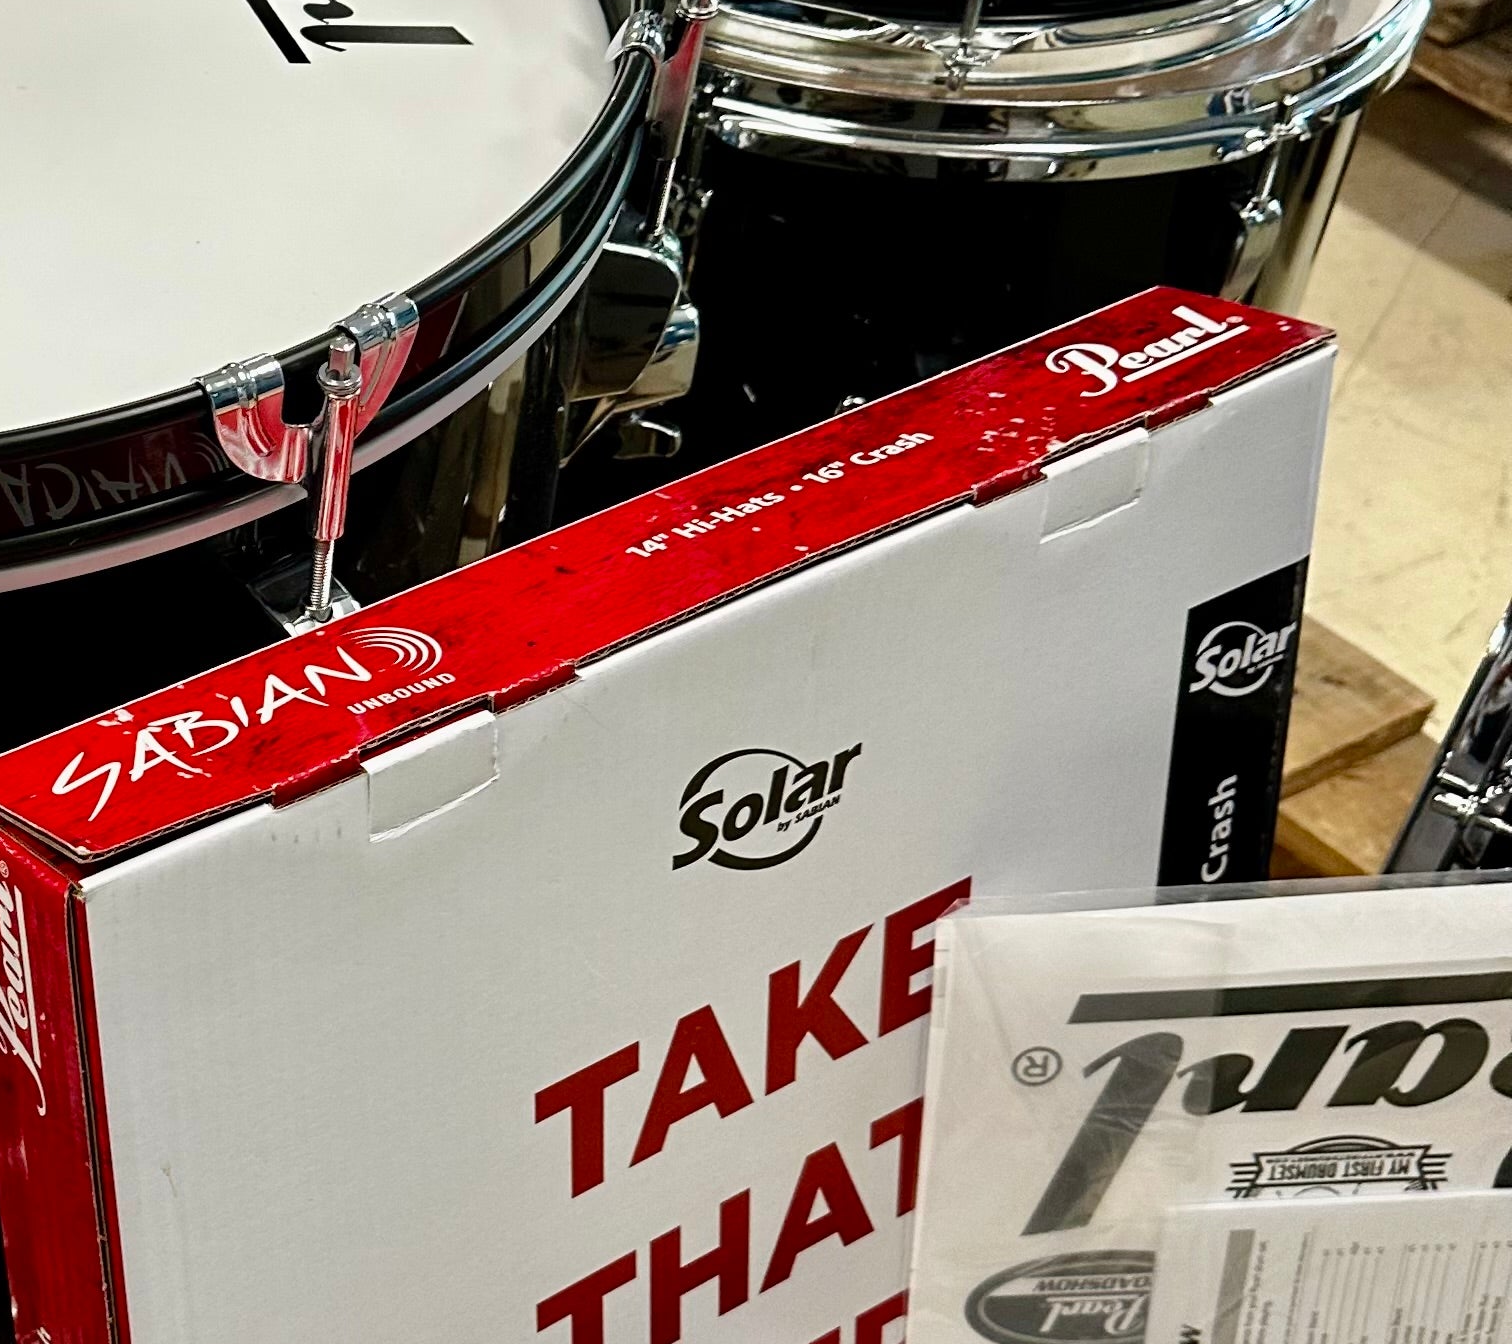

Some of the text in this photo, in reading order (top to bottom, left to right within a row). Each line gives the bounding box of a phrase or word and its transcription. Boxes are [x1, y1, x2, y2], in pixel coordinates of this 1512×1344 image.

[1045, 305, 1230, 397] Pearl
[625, 431, 934, 558] 14" Hi-Hats 16" Crash
[346, 672, 456, 716] UNBOUND
[1189, 621, 1297, 693] Solar
[51, 645, 372, 822] SABIAN
[672, 742, 863, 871] Solar
[1201, 773, 1238, 884] Crash
[534, 875, 973, 1199] TAKE
[1021, 1017, 1512, 1236] arl
[1034, 1275, 1153, 1293] OADSHOW
